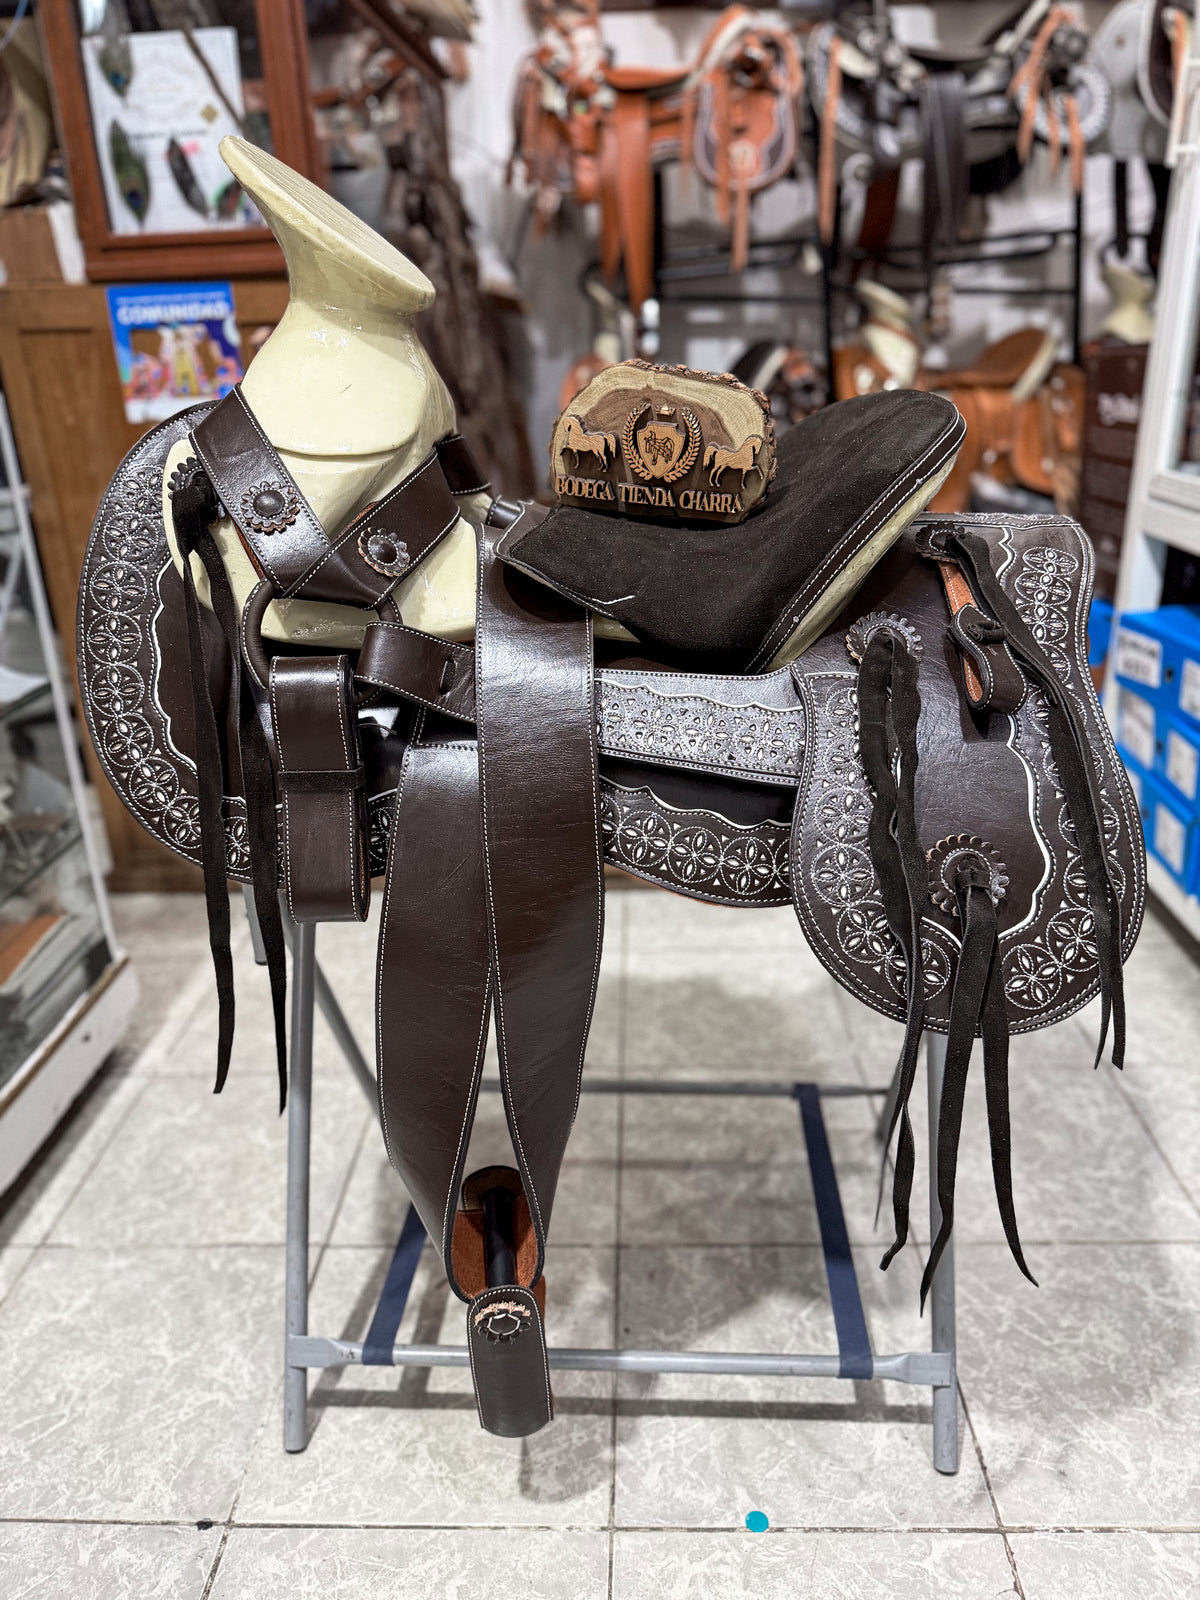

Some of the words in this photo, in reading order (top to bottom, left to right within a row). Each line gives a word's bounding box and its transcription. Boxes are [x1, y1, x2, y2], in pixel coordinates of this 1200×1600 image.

[555, 474, 615, 501] BODEGA
[618, 482, 676, 508] TIENDA
[679, 489, 744, 514] CHARRA
